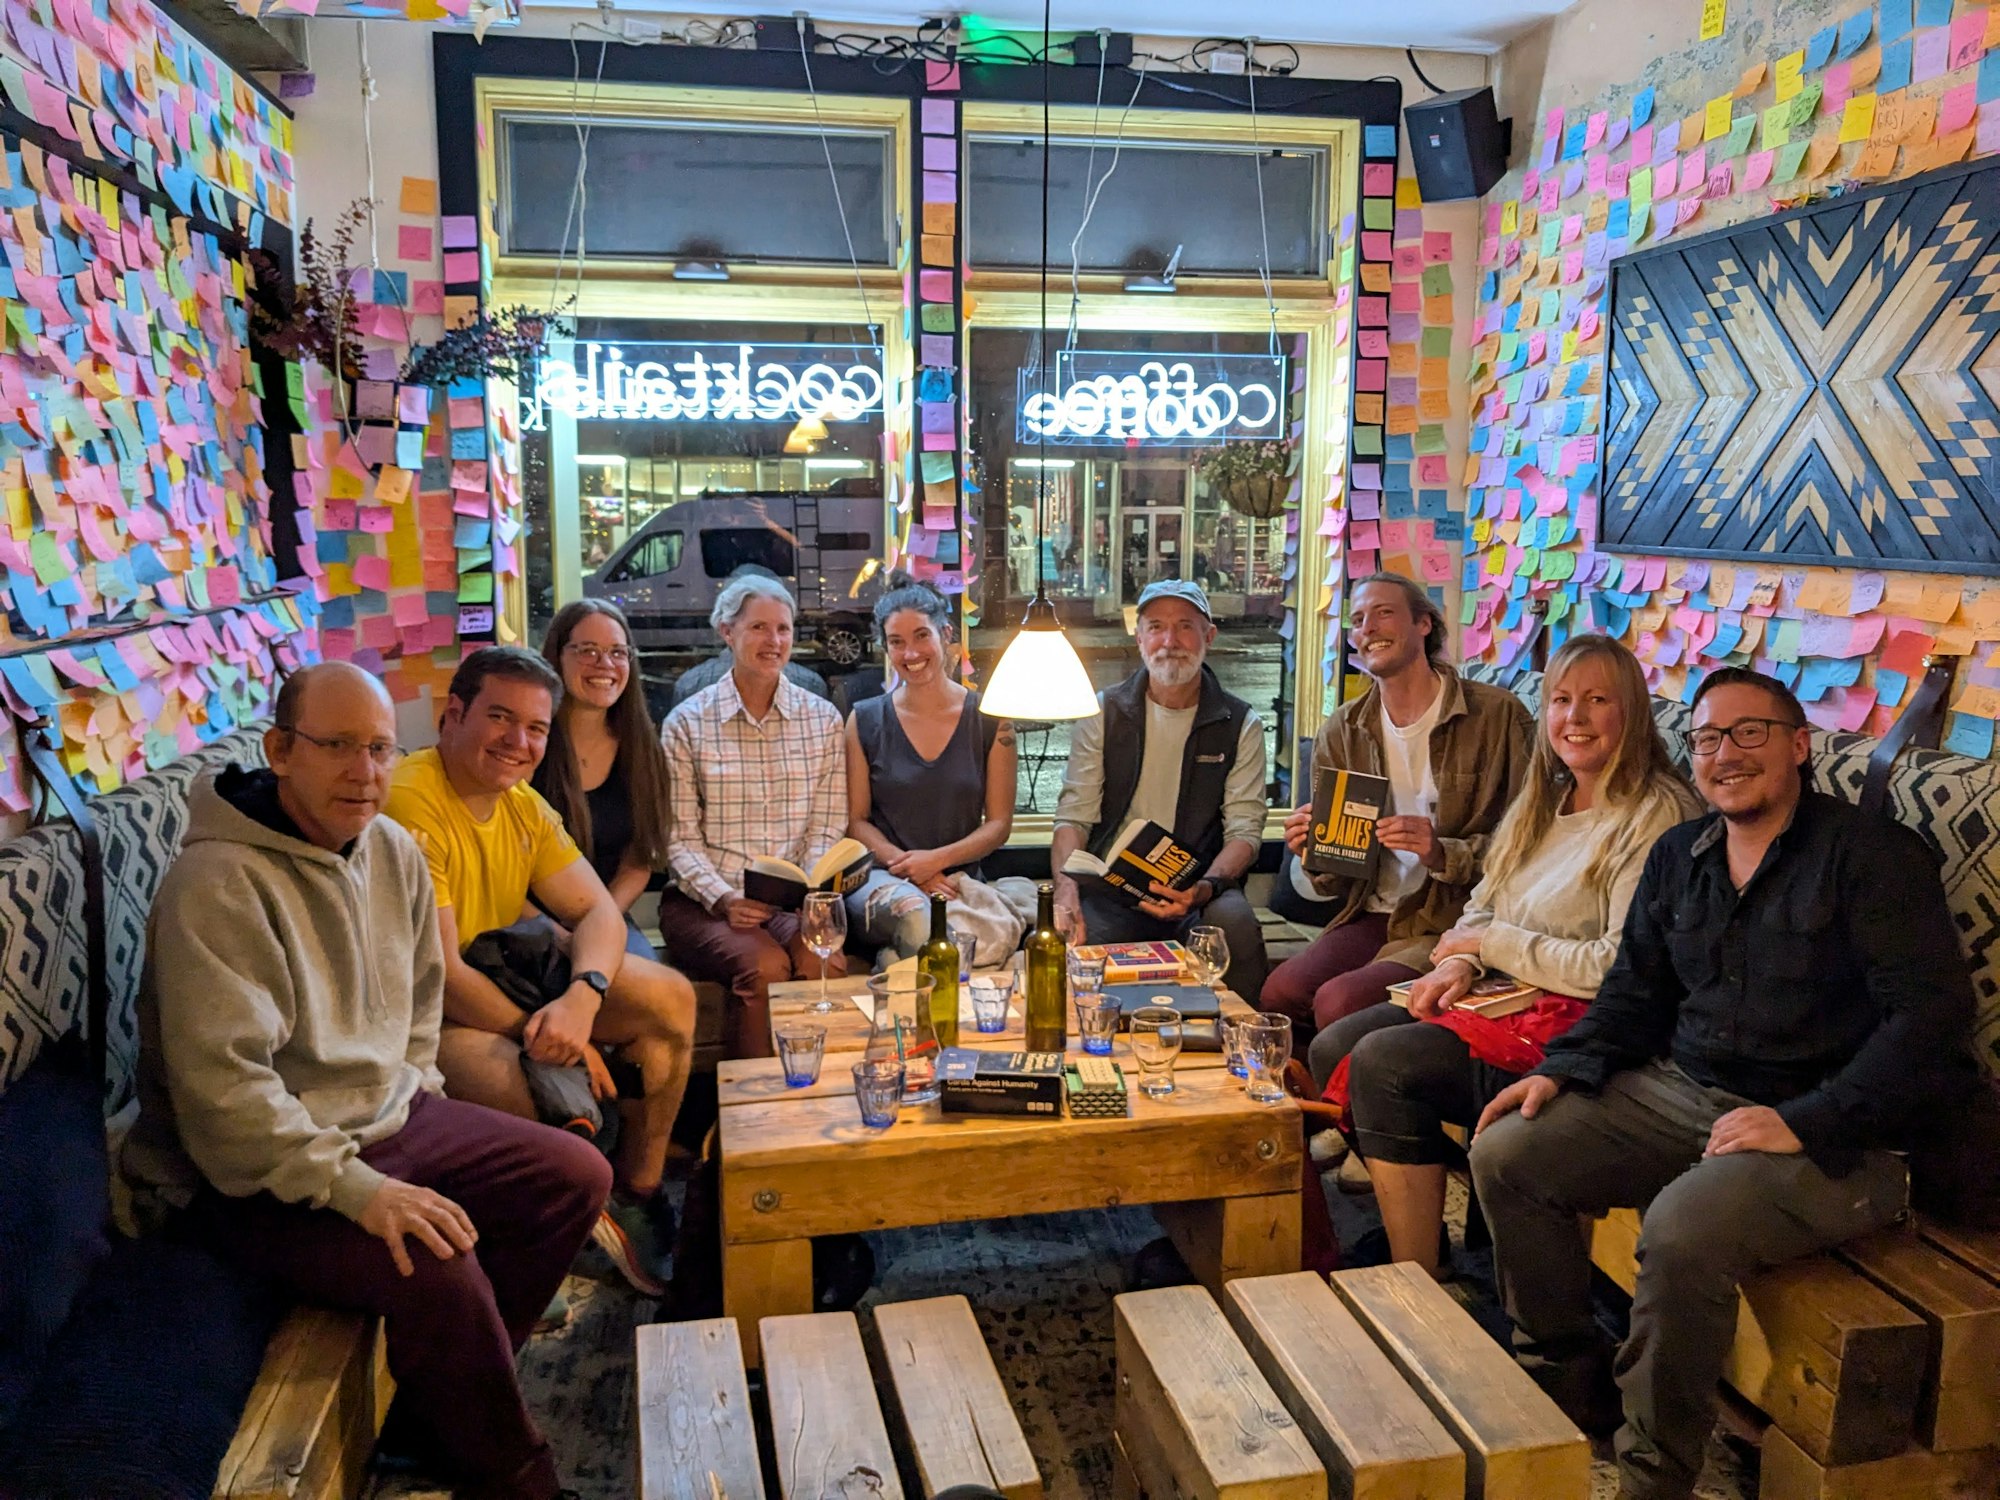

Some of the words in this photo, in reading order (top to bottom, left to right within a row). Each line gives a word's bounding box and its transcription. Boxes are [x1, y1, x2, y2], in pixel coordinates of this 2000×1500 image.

[1314, 770, 1373, 850] JAMES
[1314, 843, 1341, 856] PERCIVAL
[1341, 848, 1367, 860] EVERETT
[971, 1080, 1001, 1088] Against
[1001, 1080, 1039, 1091] Humanity
